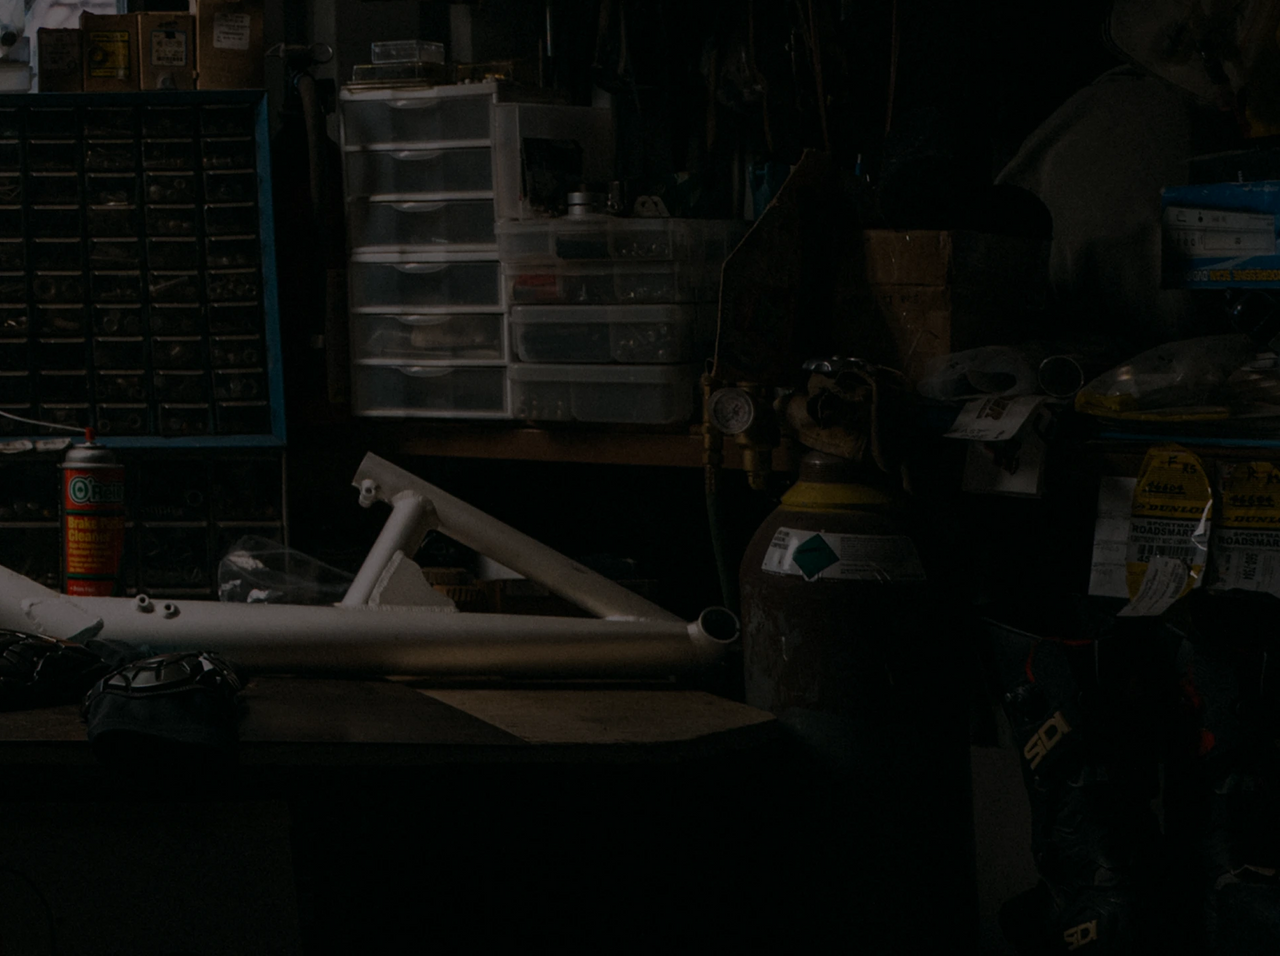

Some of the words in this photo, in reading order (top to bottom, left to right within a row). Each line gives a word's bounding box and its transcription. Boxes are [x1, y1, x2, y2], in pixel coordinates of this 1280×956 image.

[67, 516, 97, 530] Brake
[67, 528, 112, 543] Cleaner
[1131, 524, 1196, 537] ROADSMART
